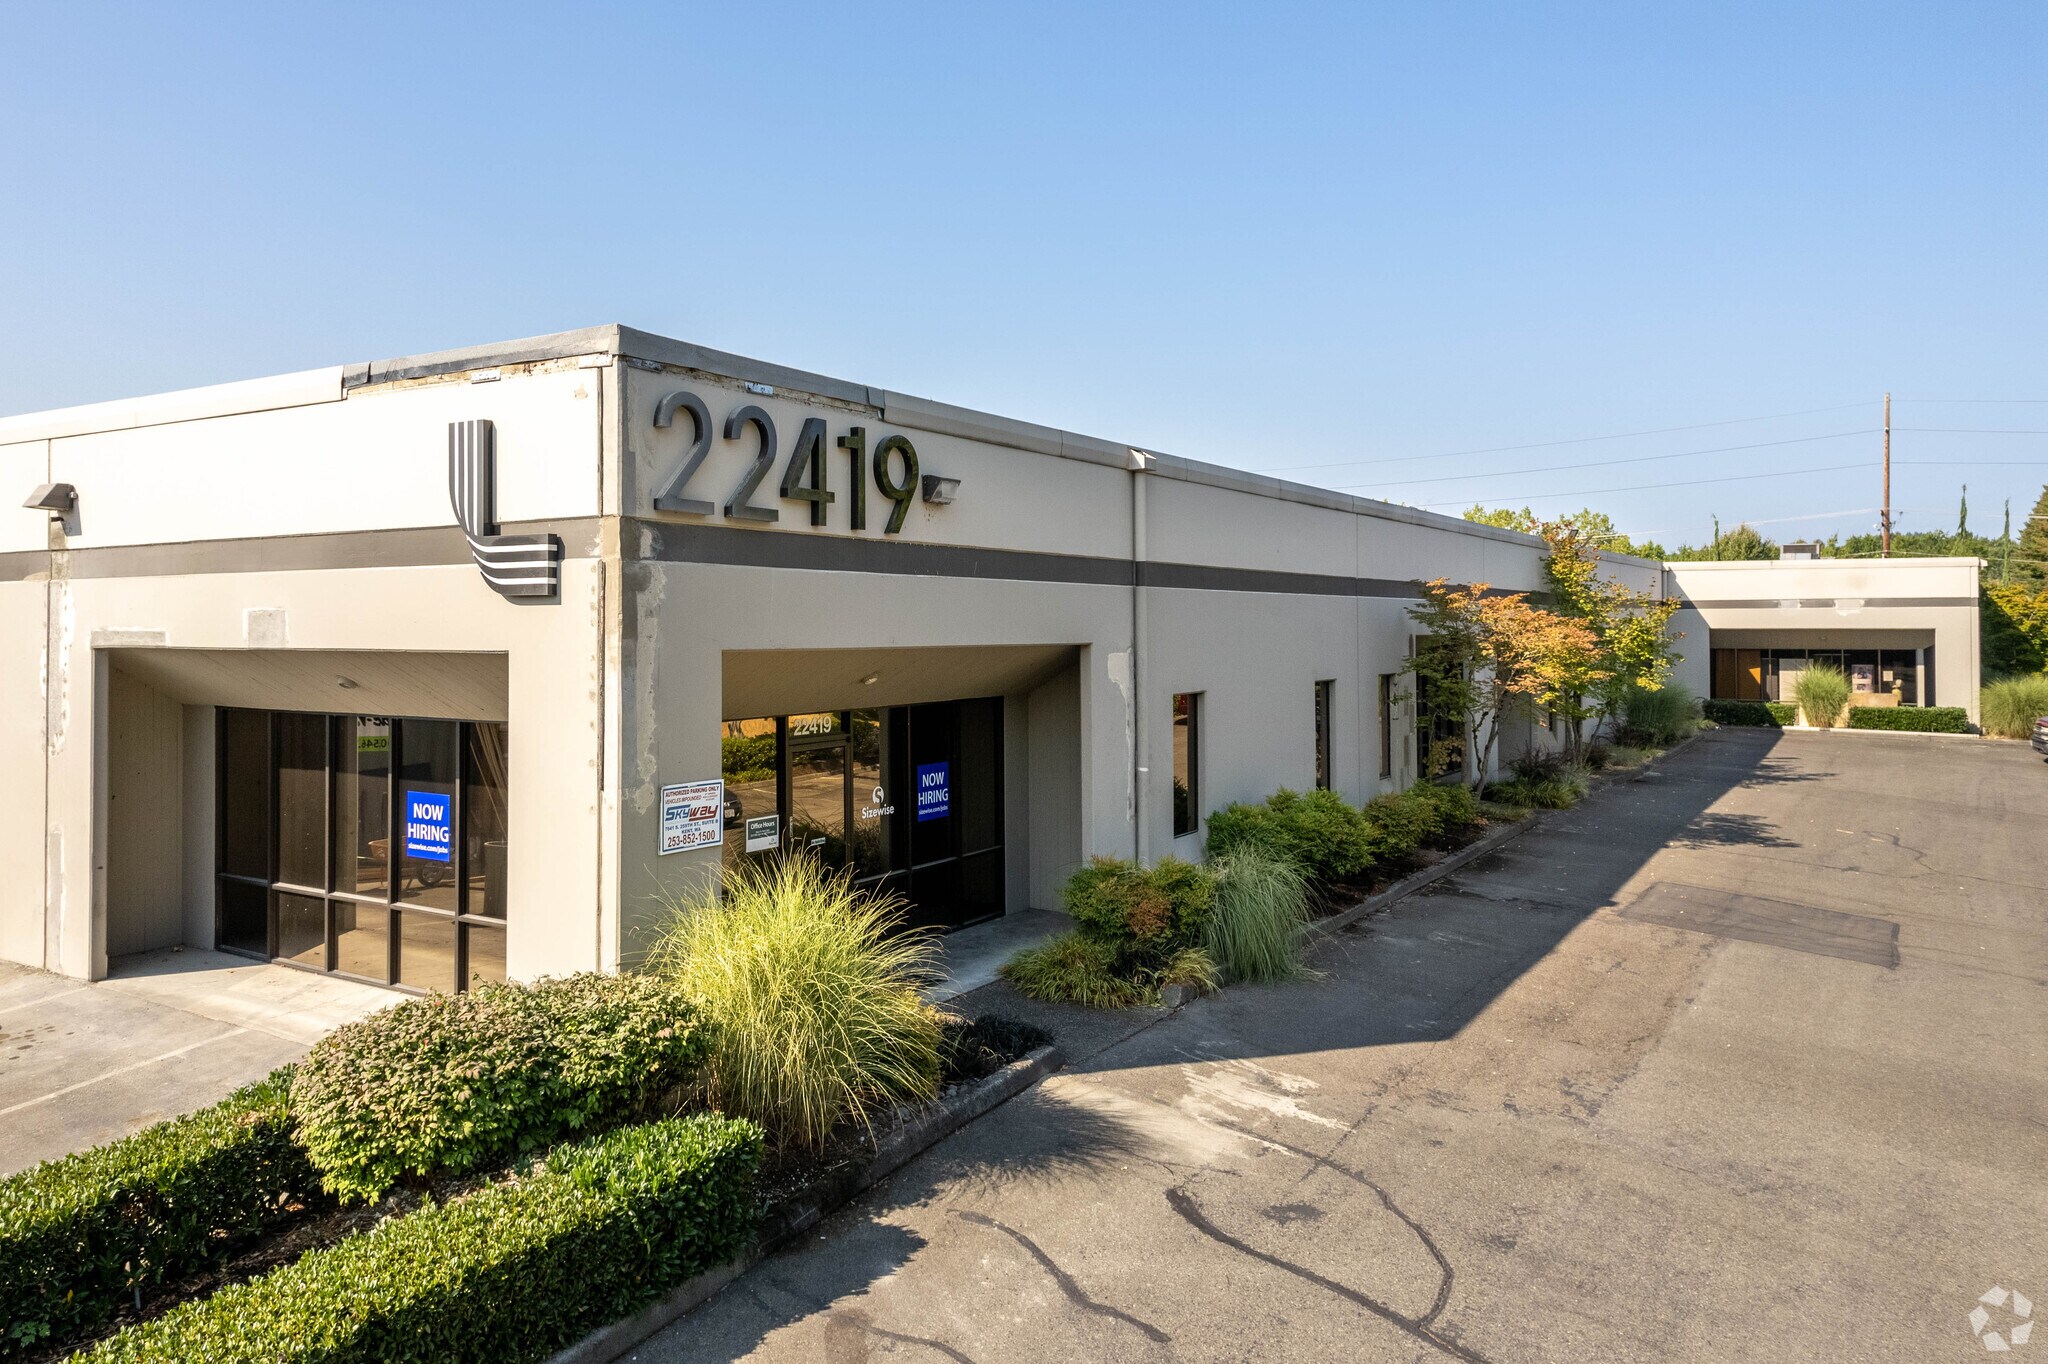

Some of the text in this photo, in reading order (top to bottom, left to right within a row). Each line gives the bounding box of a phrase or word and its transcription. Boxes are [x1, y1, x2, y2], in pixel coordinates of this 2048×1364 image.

[653, 391, 919, 534] 22419
[793, 716, 832, 736] 22419
[922, 771, 945, 787] NOW
[665, 789, 690, 797] AUTHORIZED
[918, 788, 948, 806] HIRING
[413, 802, 444, 821] NOW
[861, 804, 895, 819] Sizewise
[408, 822, 449, 842] HIRING
[750, 822, 763, 830] Office
[667, 830, 715, 848] 253-852-1500
